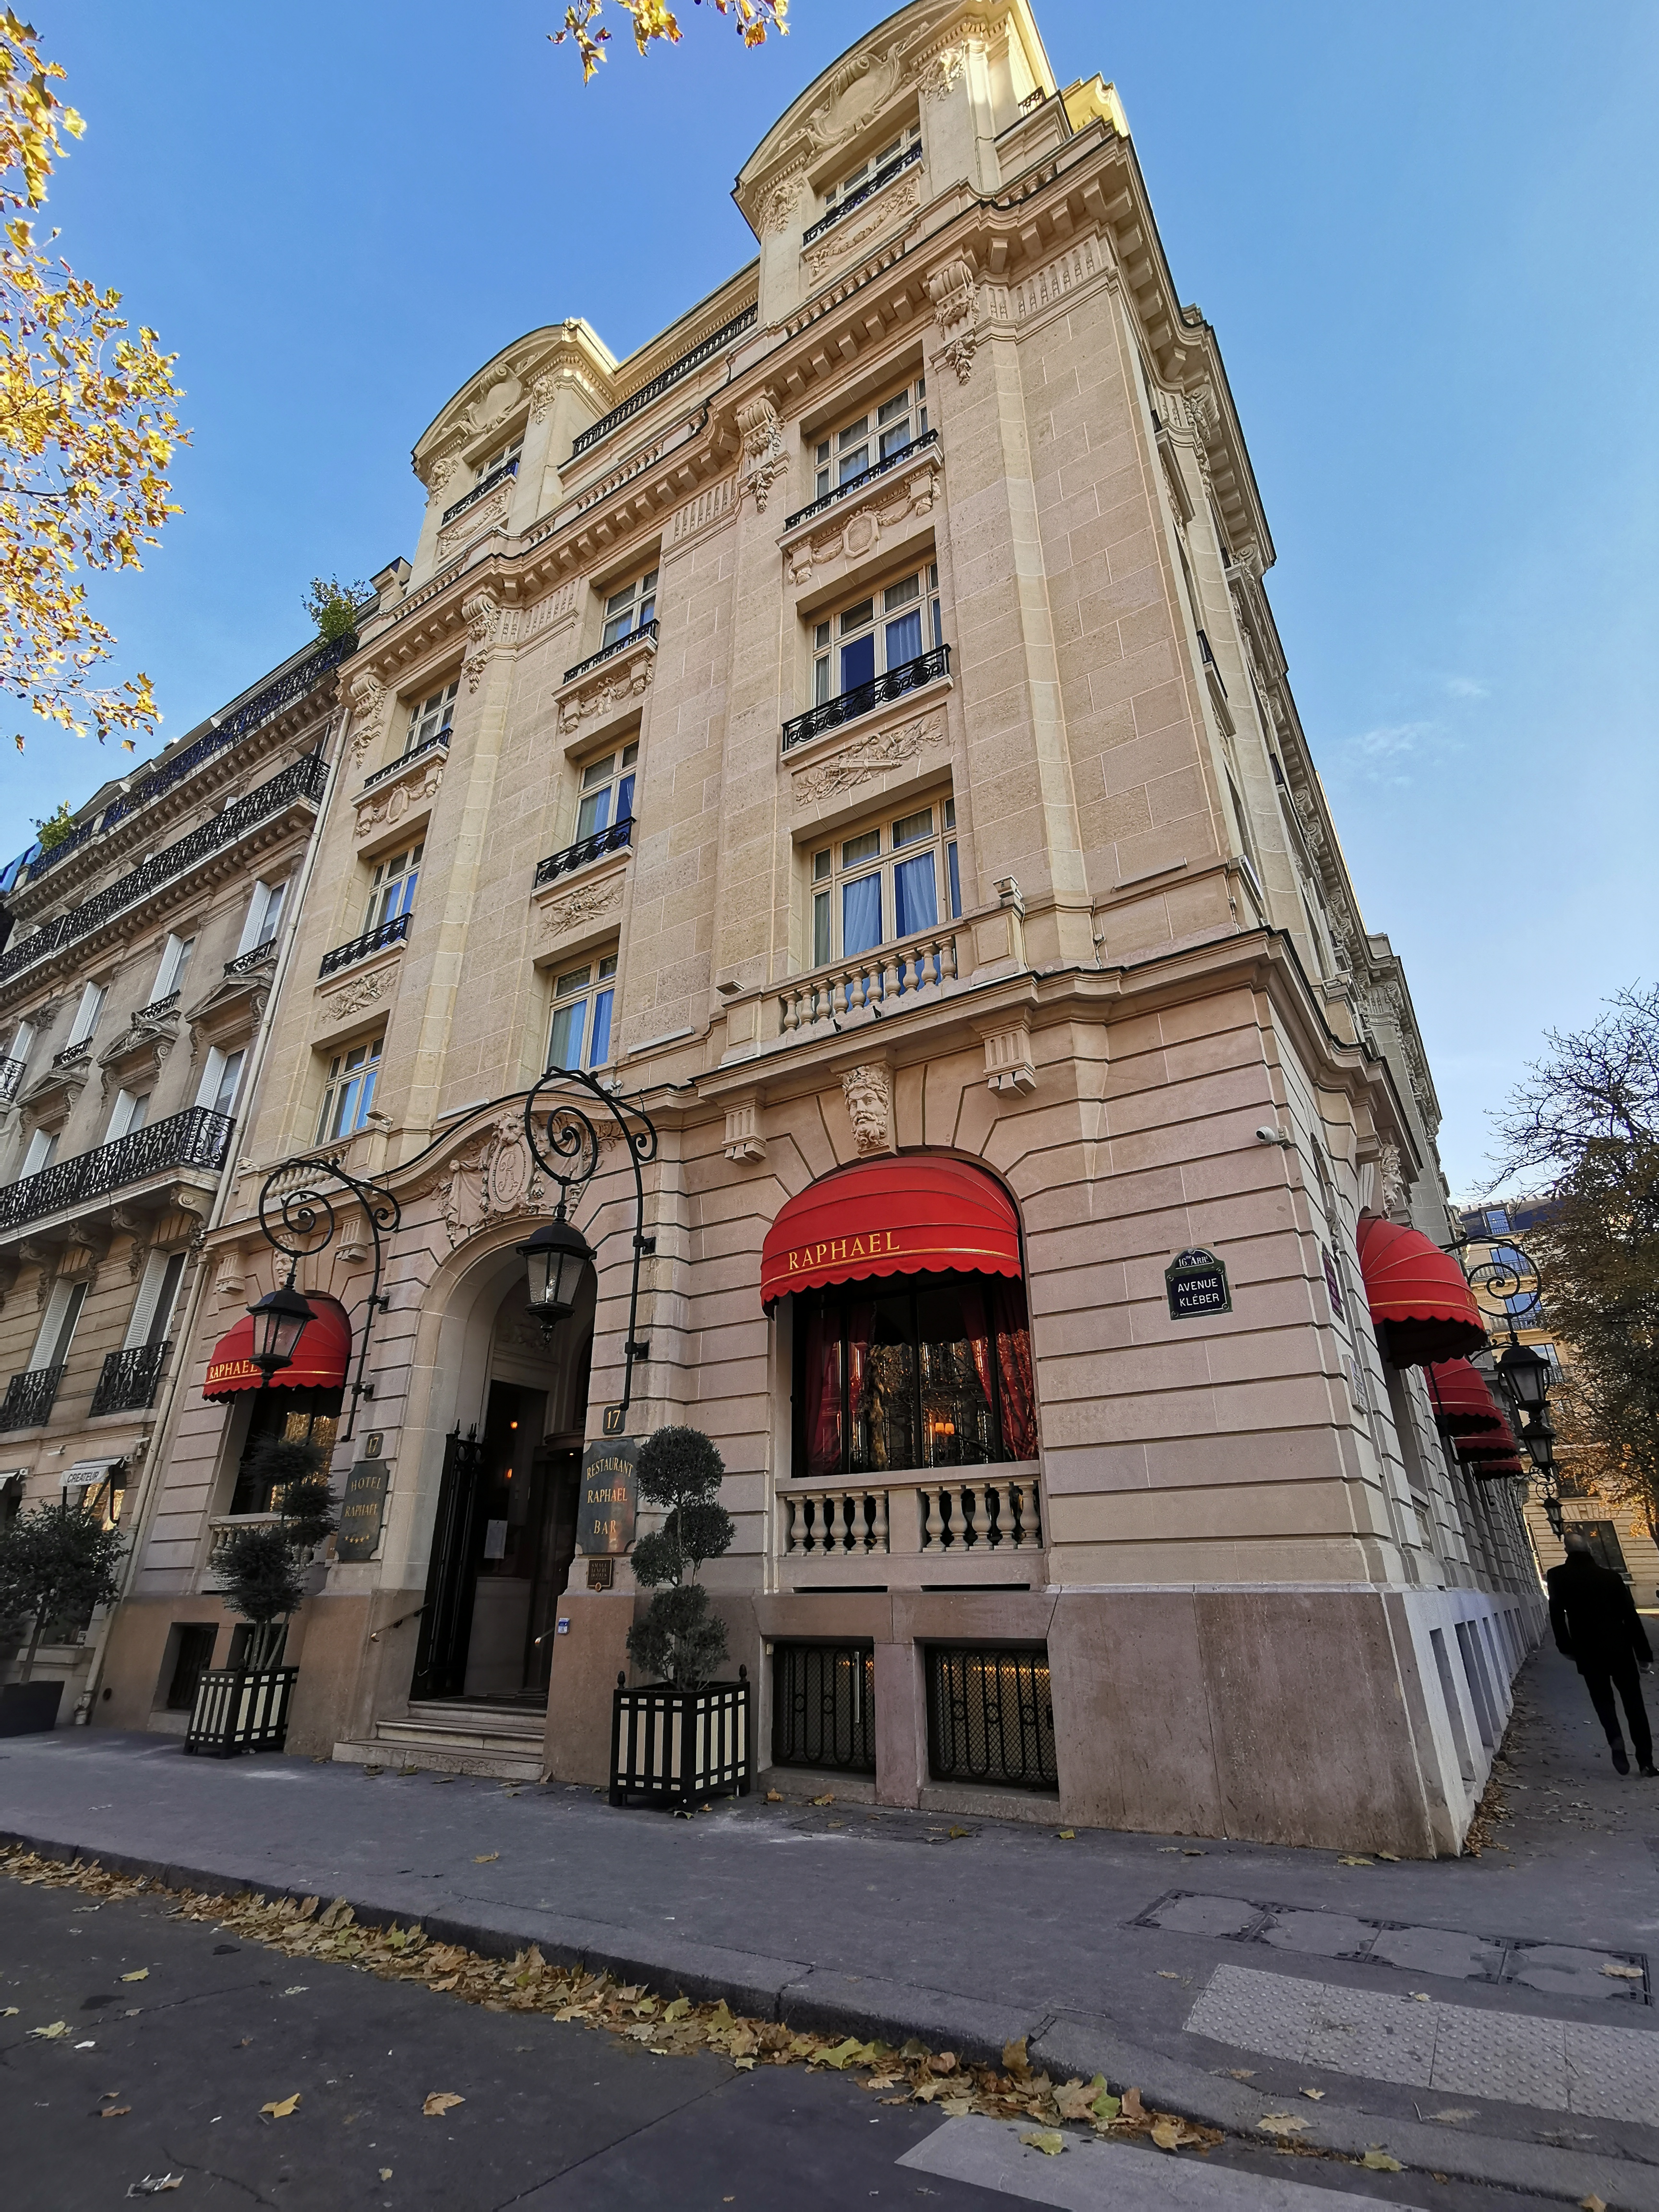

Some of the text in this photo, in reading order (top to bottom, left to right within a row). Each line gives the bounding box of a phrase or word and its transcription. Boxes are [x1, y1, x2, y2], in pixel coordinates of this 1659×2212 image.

[788, 1231, 900, 1271] RAPHAEL
[1178, 1278, 1218, 1293] AVENUE
[1179, 1293, 1220, 1307] KLÉBER
[209, 1360, 258, 1380] RAPHAEL
[606, 1409, 621, 1429] 17
[367, 1437, 380, 1454] 17
[587, 1457, 634, 1481] RESTAURANT
[351, 1476, 382, 1492] HOTEL
[587, 1487, 628, 1504] RAPHAEL
[344, 1503, 378, 1517] RAPHAEL
[593, 1519, 617, 1535] BAR
